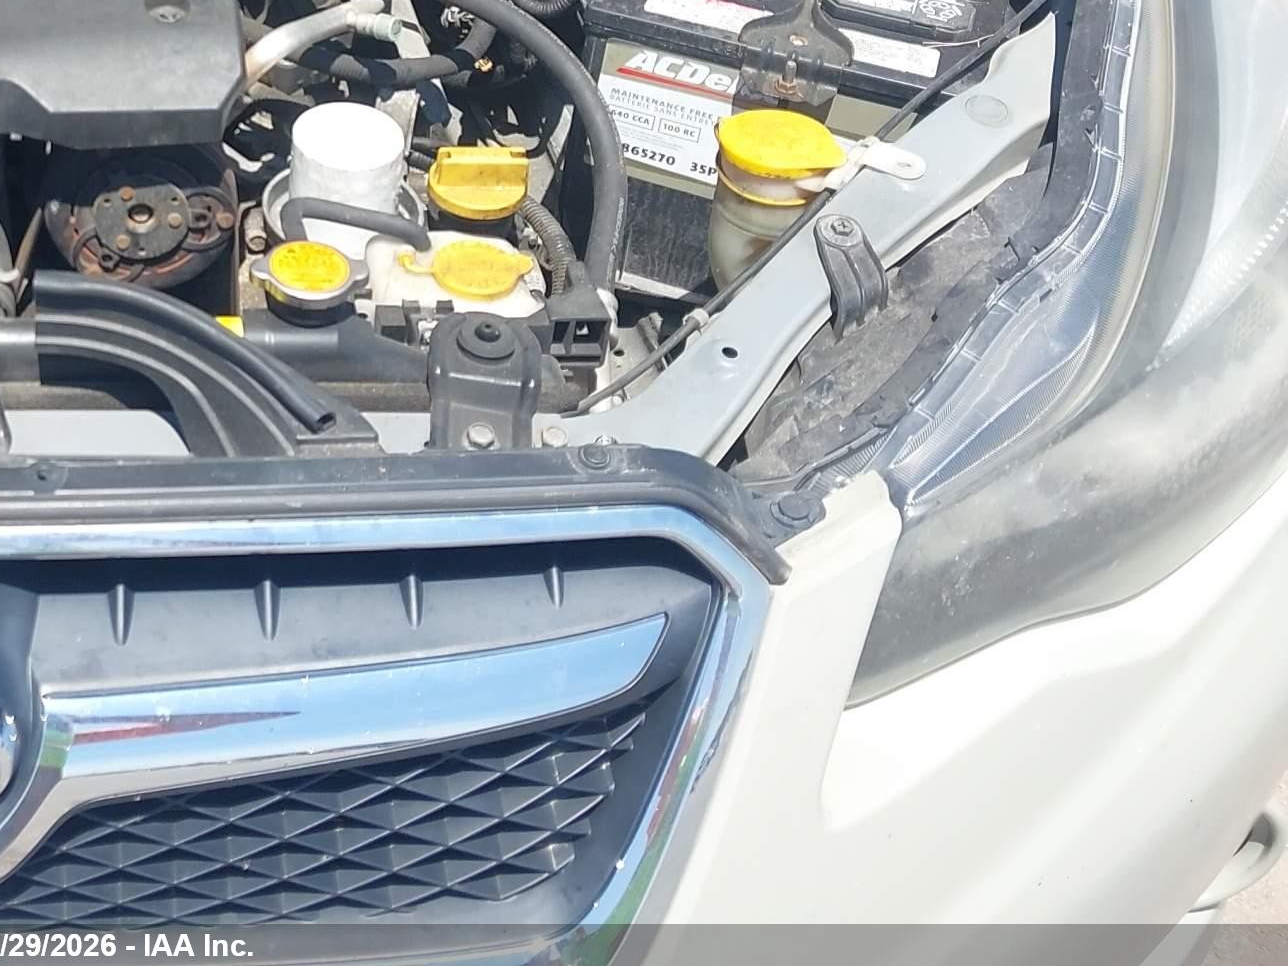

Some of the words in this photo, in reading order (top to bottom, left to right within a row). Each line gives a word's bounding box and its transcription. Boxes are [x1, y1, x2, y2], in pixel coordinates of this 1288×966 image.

[611, 87, 685, 113] MAINTENANCE
[689, 108, 713, 120] FREE
[632, 115, 650, 125] CCA
[663, 122, 681, 134] 100
[683, 127, 696, 138] RC
